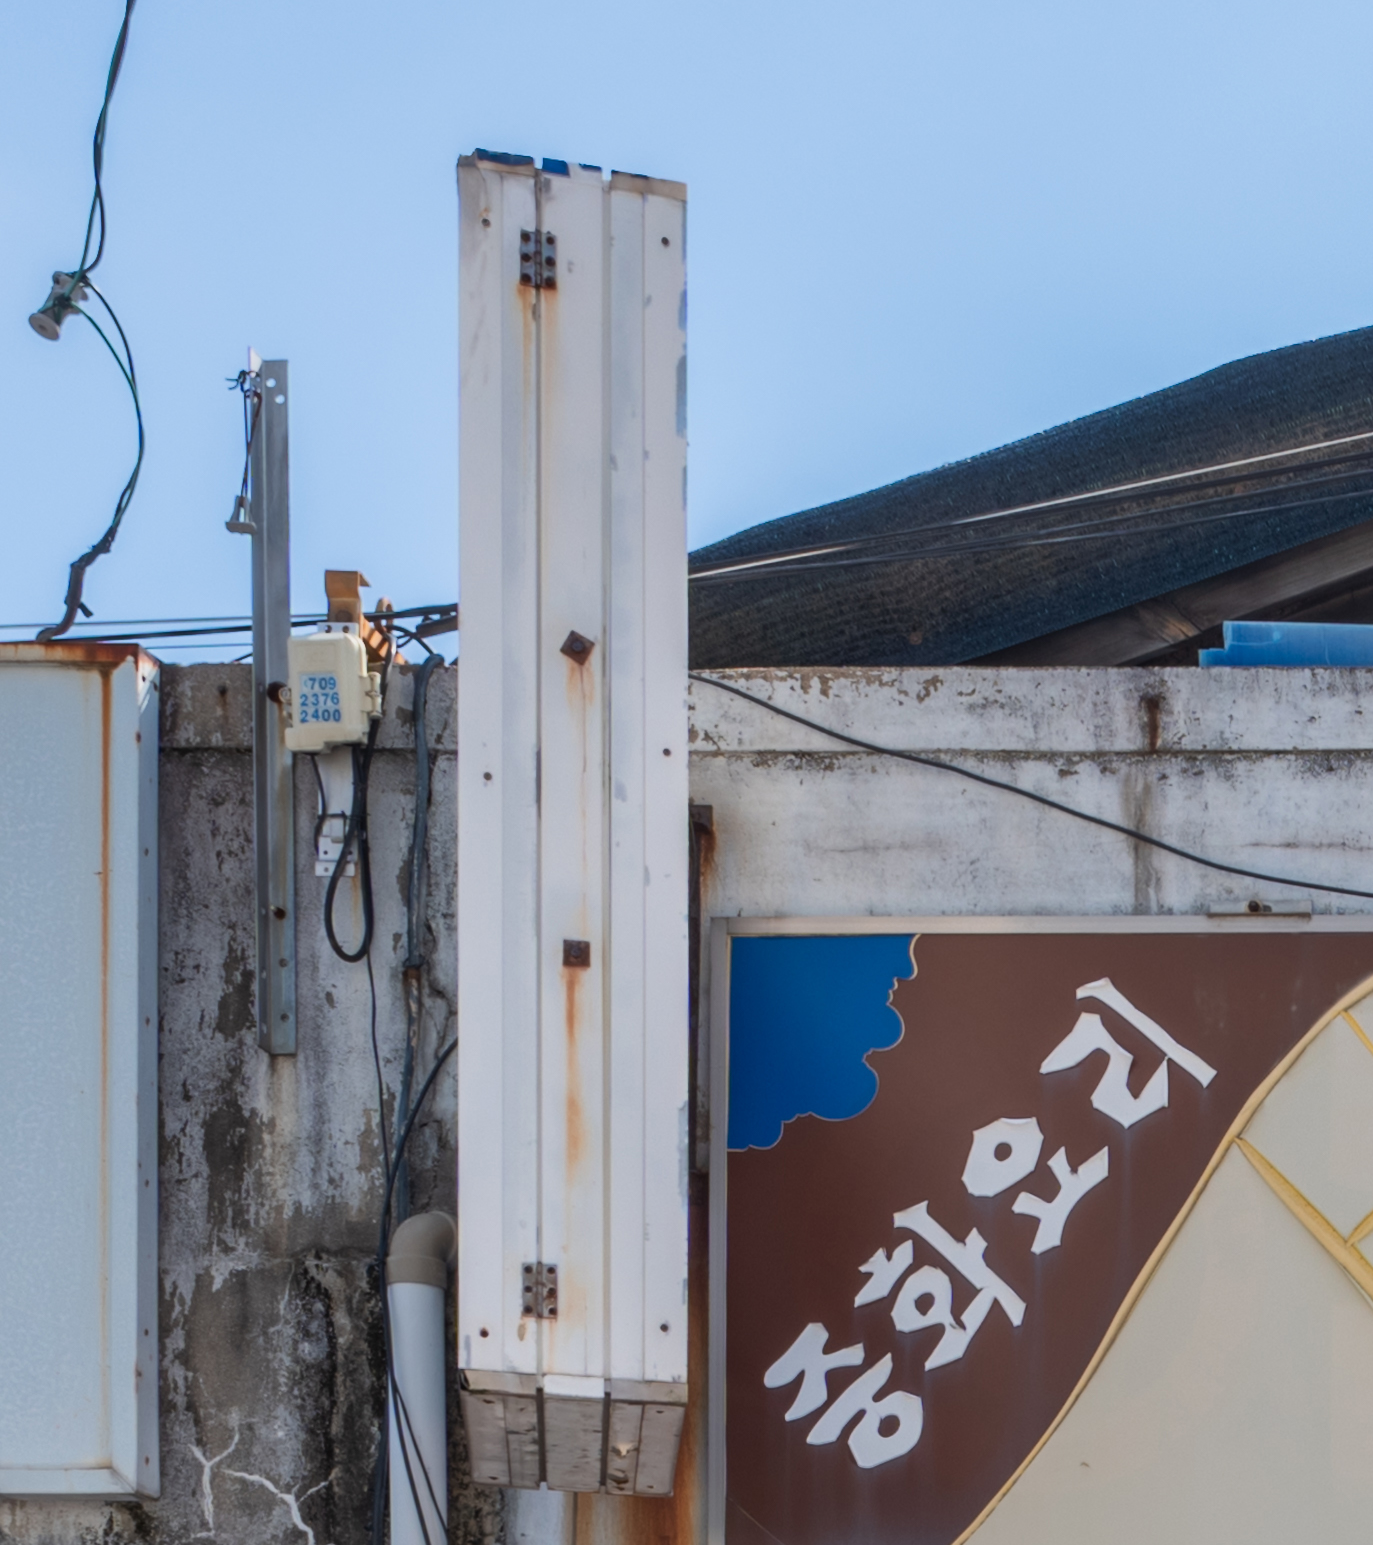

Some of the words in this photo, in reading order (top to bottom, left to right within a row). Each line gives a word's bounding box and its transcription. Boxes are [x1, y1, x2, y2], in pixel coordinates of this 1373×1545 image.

[300, 692, 340, 707] 2376
[300, 708, 342, 724] 2400
[763, 976, 1216, 1469] 중화요리
